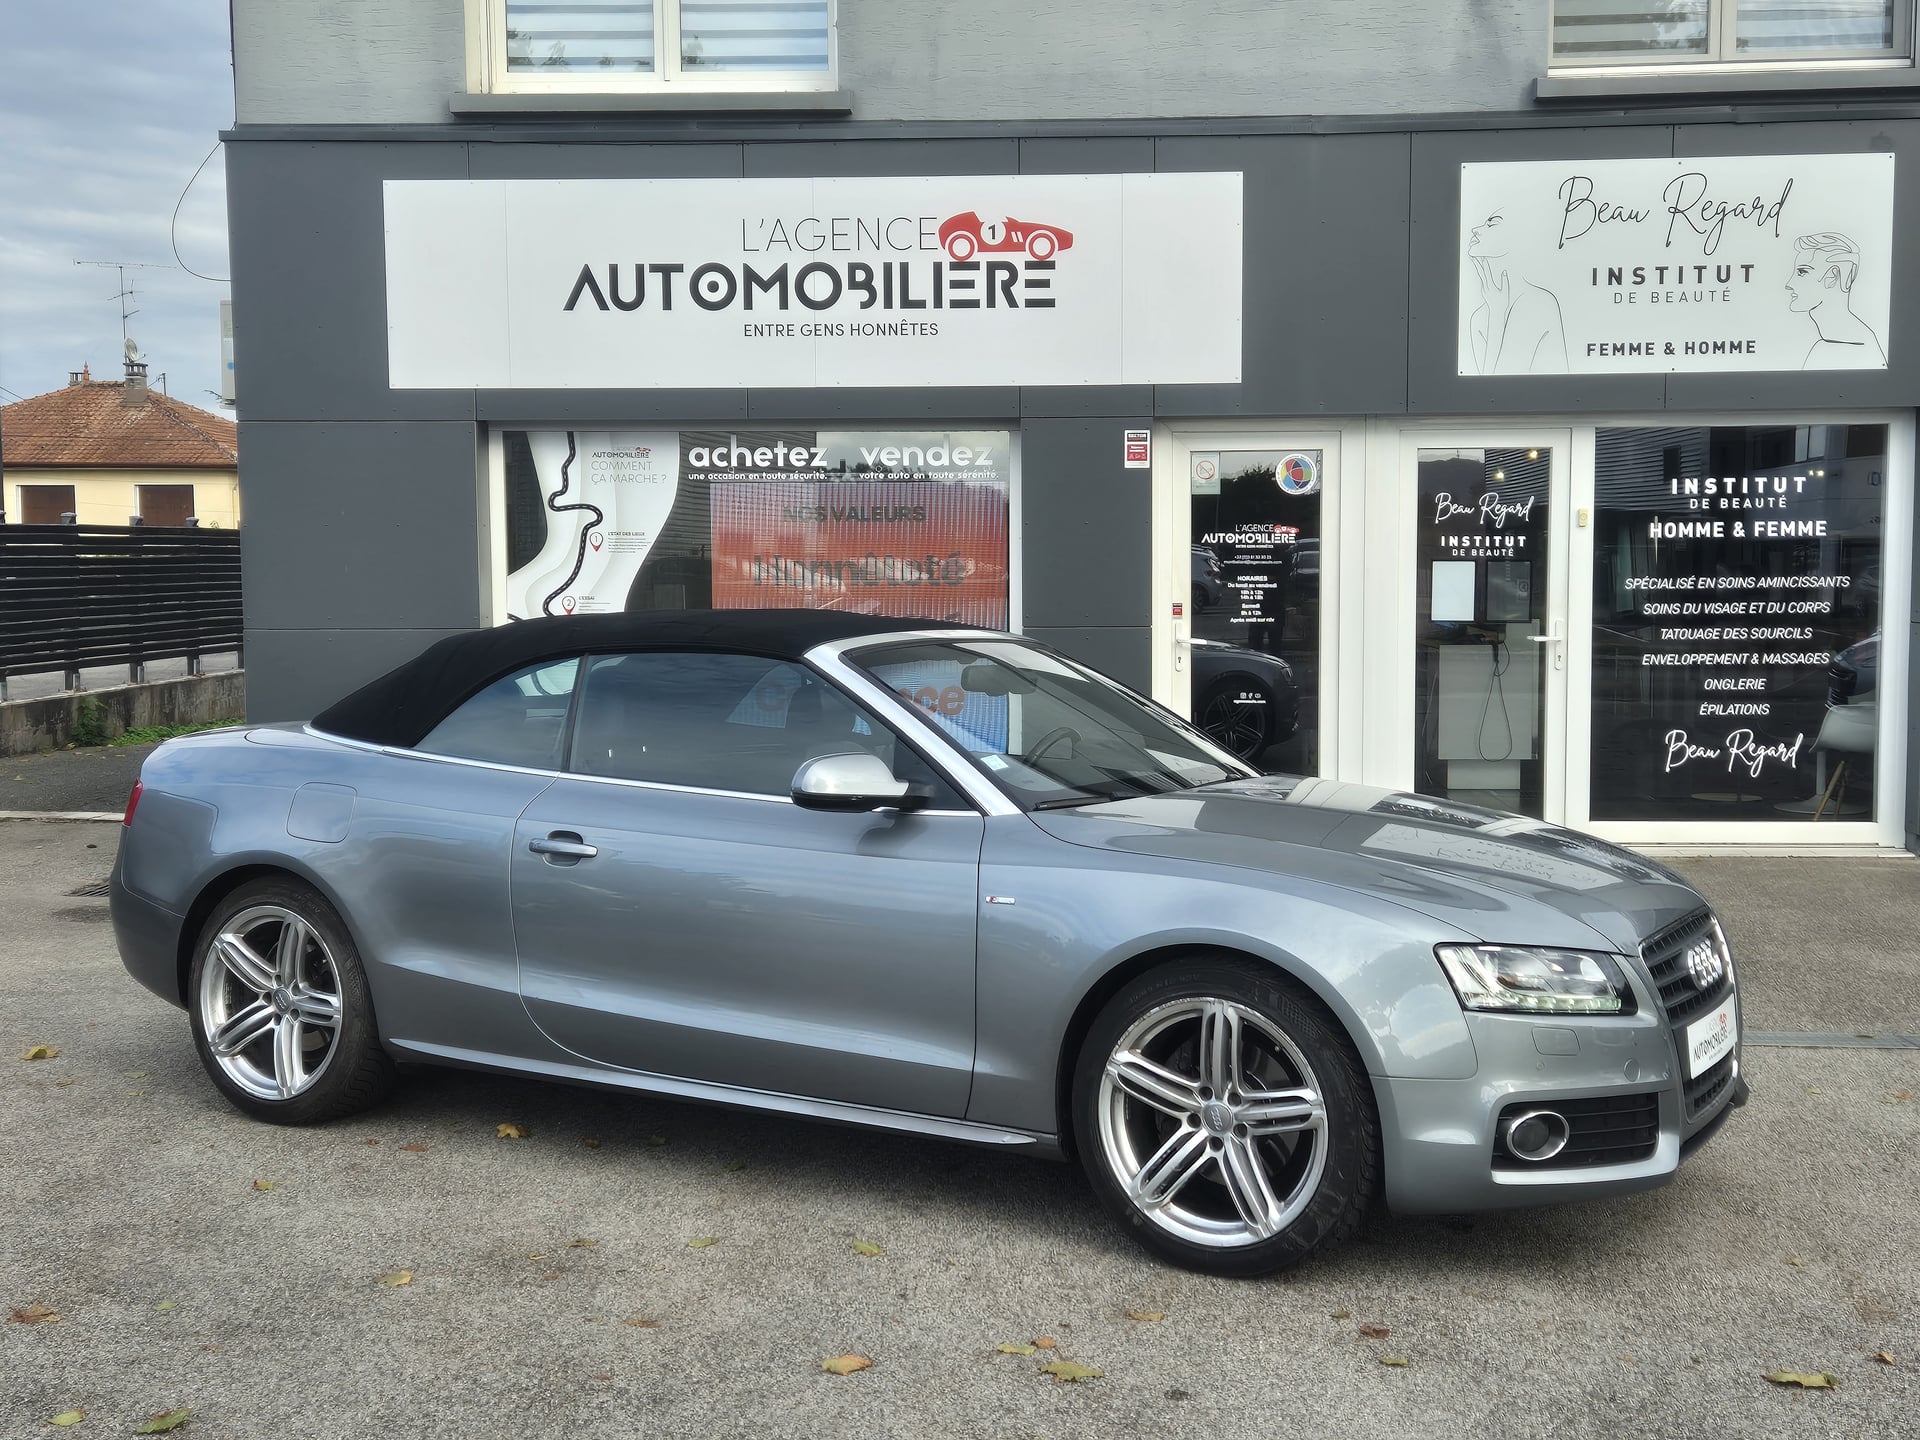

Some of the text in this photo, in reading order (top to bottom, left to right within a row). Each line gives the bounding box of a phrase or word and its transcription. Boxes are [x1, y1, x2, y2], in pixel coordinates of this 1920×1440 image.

[1558, 171, 1794, 257] Beau Regard
[742, 216, 939, 253] L'AGENCE
[986, 223, 997, 240] 1
[1591, 263, 1755, 288] INSTITUT
[562, 258, 1056, 313] AUTOMOBILIERE
[1613, 286, 1732, 304] DE BEAUTÉ
[743, 318, 939, 337] ENTRE GENS HONNÊTES
[1586, 340, 1757, 357] FEMME & HOMME
[688, 434, 828, 467] achetez
[859, 434, 993, 467] vendez
[591, 460, 653, 471] COMMENT
[591, 473, 667, 485] ÇA MARCHE ?
[708, 471, 746, 480] occasion
[763, 471, 787, 480] toute
[928, 471, 954, 479] toute
[1671, 477, 1807, 494] INSTITUT
[1435, 492, 1535, 528] Beau Regard
[1689, 495, 1787, 509] DE BEAUTÉ
[832, 506, 926, 522] VALEURS
[1235, 524, 1274, 532] L'AGENCE
[1650, 520, 1827, 538] HOMME & FEMME
[1441, 536, 1526, 547] INSTITUT
[1472, 547, 1513, 556] BEAUTÉ
[1624, 575, 1850, 590] SPÉCIALISÉ EN SOINS AMINCISSANTS
[1643, 602, 1831, 615] SOINS DU VISAGE ET DU CORPS
[1660, 627, 1813, 640] TATOUAGE DES SOURCILS
[1642, 652, 1831, 666] ENVELOPPEMENT & MASSAGES
[1704, 678, 1767, 690] ONGLERIE
[1699, 702, 1771, 716] ÉPILATIONS
[1665, 729, 1804, 778] Beau Regard
